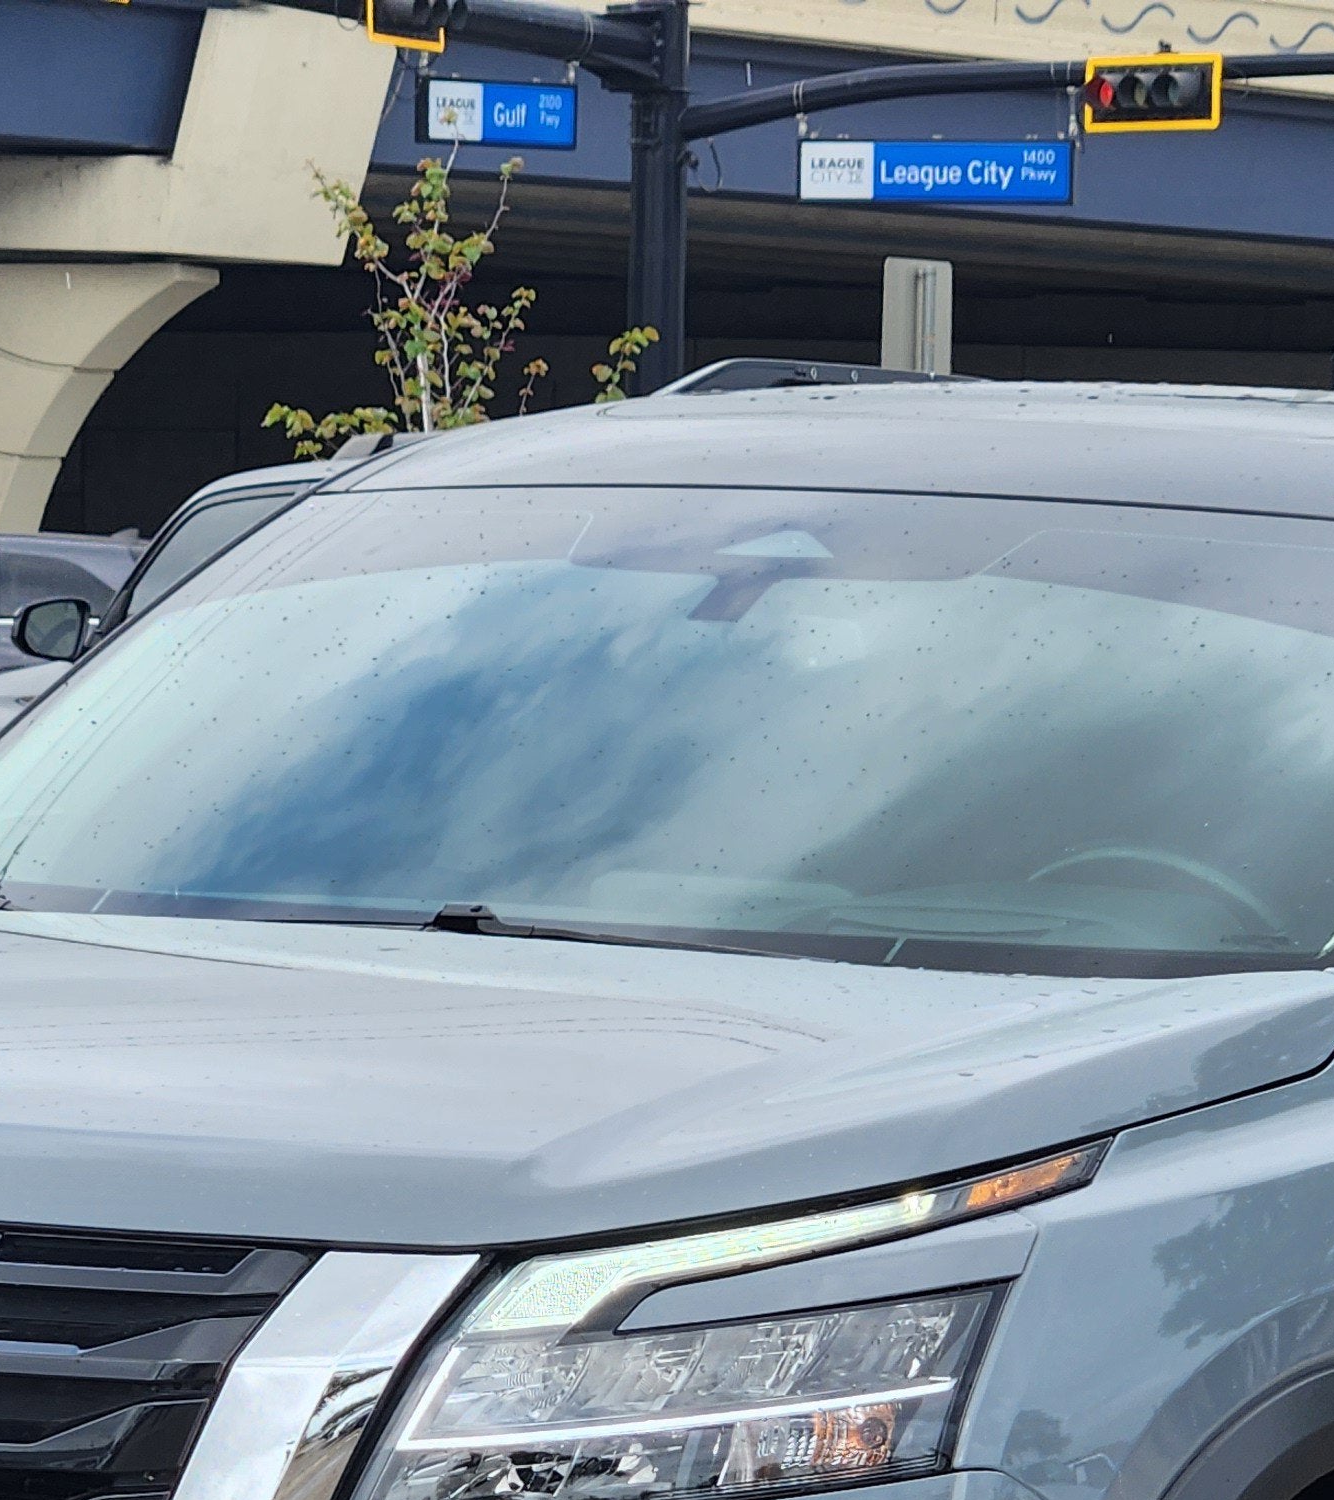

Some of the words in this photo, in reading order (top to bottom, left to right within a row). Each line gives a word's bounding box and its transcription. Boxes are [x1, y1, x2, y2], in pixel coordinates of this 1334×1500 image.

[436, 97, 476, 110] LEAGUE
[493, 102, 528, 128] Gulf
[811, 157, 865, 170] LEAGUE
[1022, 149, 1056, 165] 1400
[811, 170, 842, 183] CITY
[880, 160, 963, 191] League
[967, 160, 1014, 190] City
[1021, 166, 1056, 184] Pkwy
